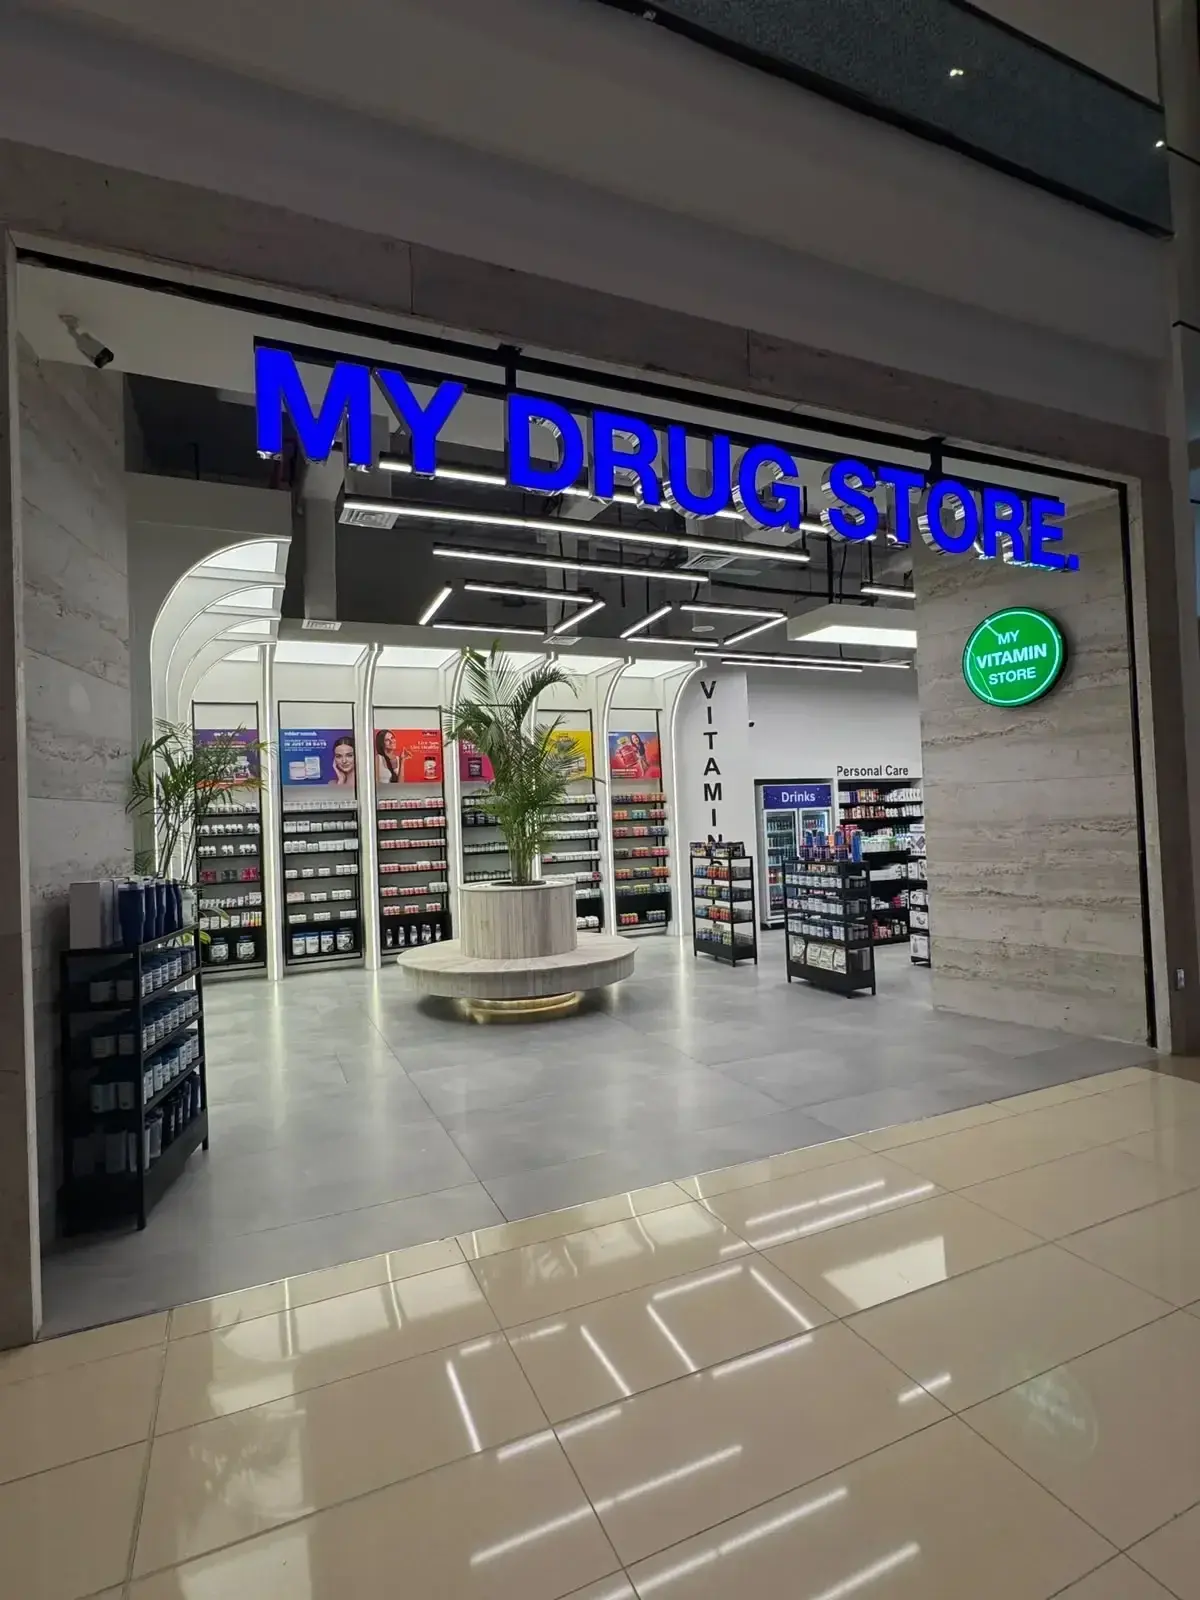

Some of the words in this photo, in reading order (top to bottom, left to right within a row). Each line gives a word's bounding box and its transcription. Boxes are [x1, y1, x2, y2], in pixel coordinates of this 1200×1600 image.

[256, 347, 464, 473] MY
[509, 394, 801, 529] DRUG
[998, 630, 1019, 645] MY
[976, 643, 1047, 669] VITAMIN
[988, 667, 1036, 685] STORE
[700, 680, 723, 866] VITAMI
[836, 765, 883, 777] Personal
[885, 764, 909, 776] Care
[781, 791, 816, 803] Drinks
